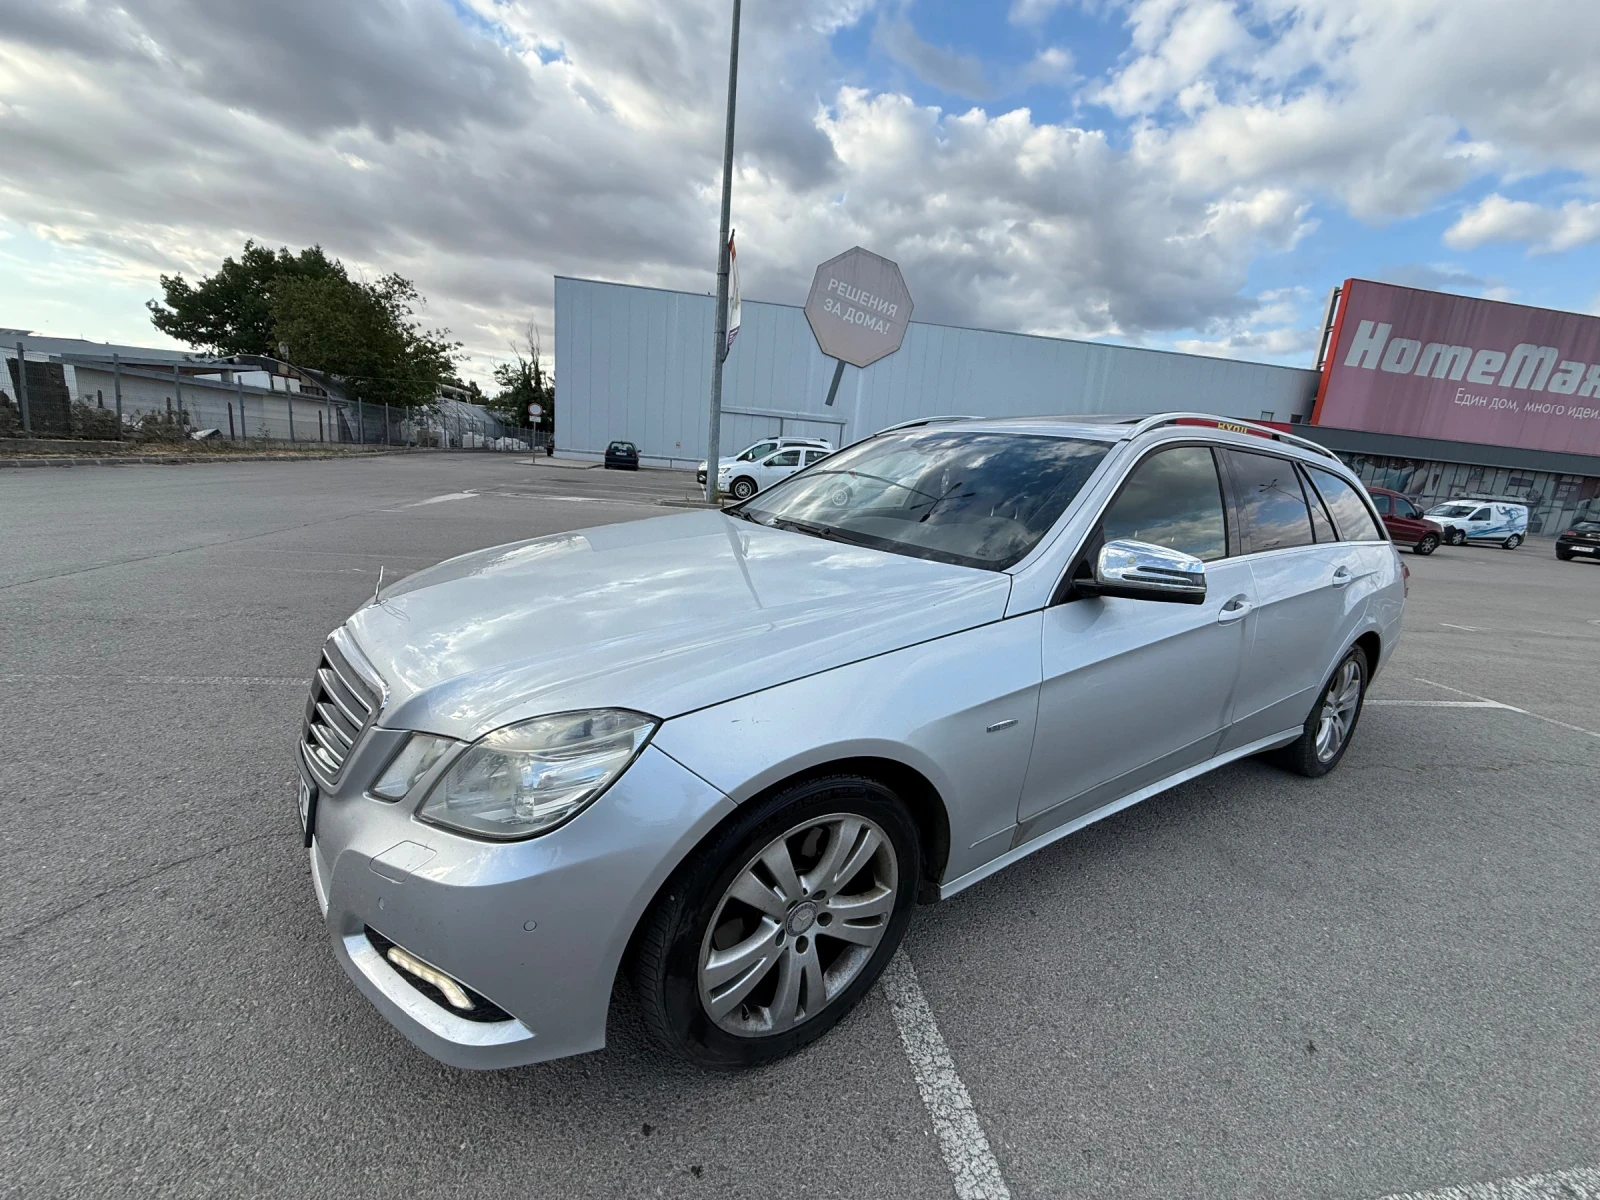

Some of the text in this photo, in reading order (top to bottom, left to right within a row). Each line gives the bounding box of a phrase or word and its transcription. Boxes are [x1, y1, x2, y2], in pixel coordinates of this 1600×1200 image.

[823, 298, 890, 335] ЗА ДОМА!
[827, 278, 898, 318] РЕШЕНИЯ
[1454, 388, 1488, 406] Един
[1488, 398, 1519, 413] дом,
[1524, 403, 1565, 416] много
